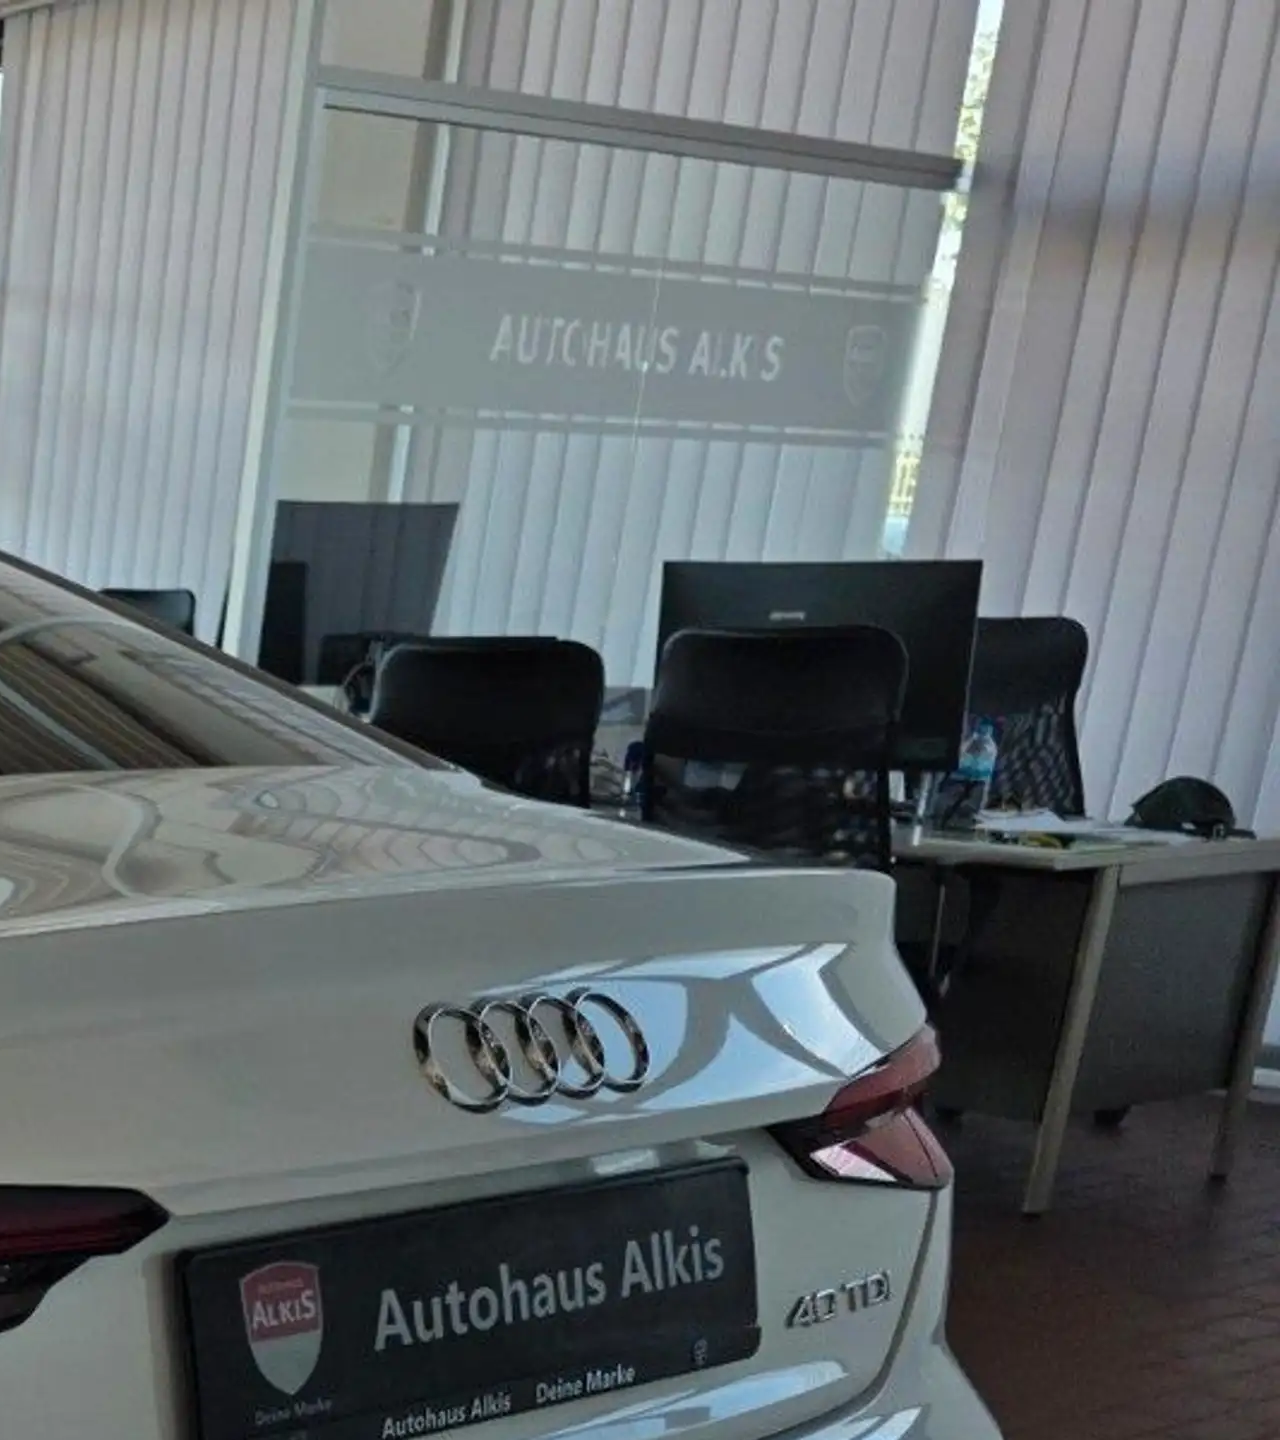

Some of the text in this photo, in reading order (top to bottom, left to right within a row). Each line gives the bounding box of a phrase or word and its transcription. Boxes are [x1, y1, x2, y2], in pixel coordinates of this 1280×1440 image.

[489, 314, 785, 382] AUTOHAUS ALKS
[374, 1224, 725, 1352] Autohaus Alkis
[840, 1271, 891, 1312] TDI
[381, 1363, 636, 1440] Autohaus Alkis Deine Marke
